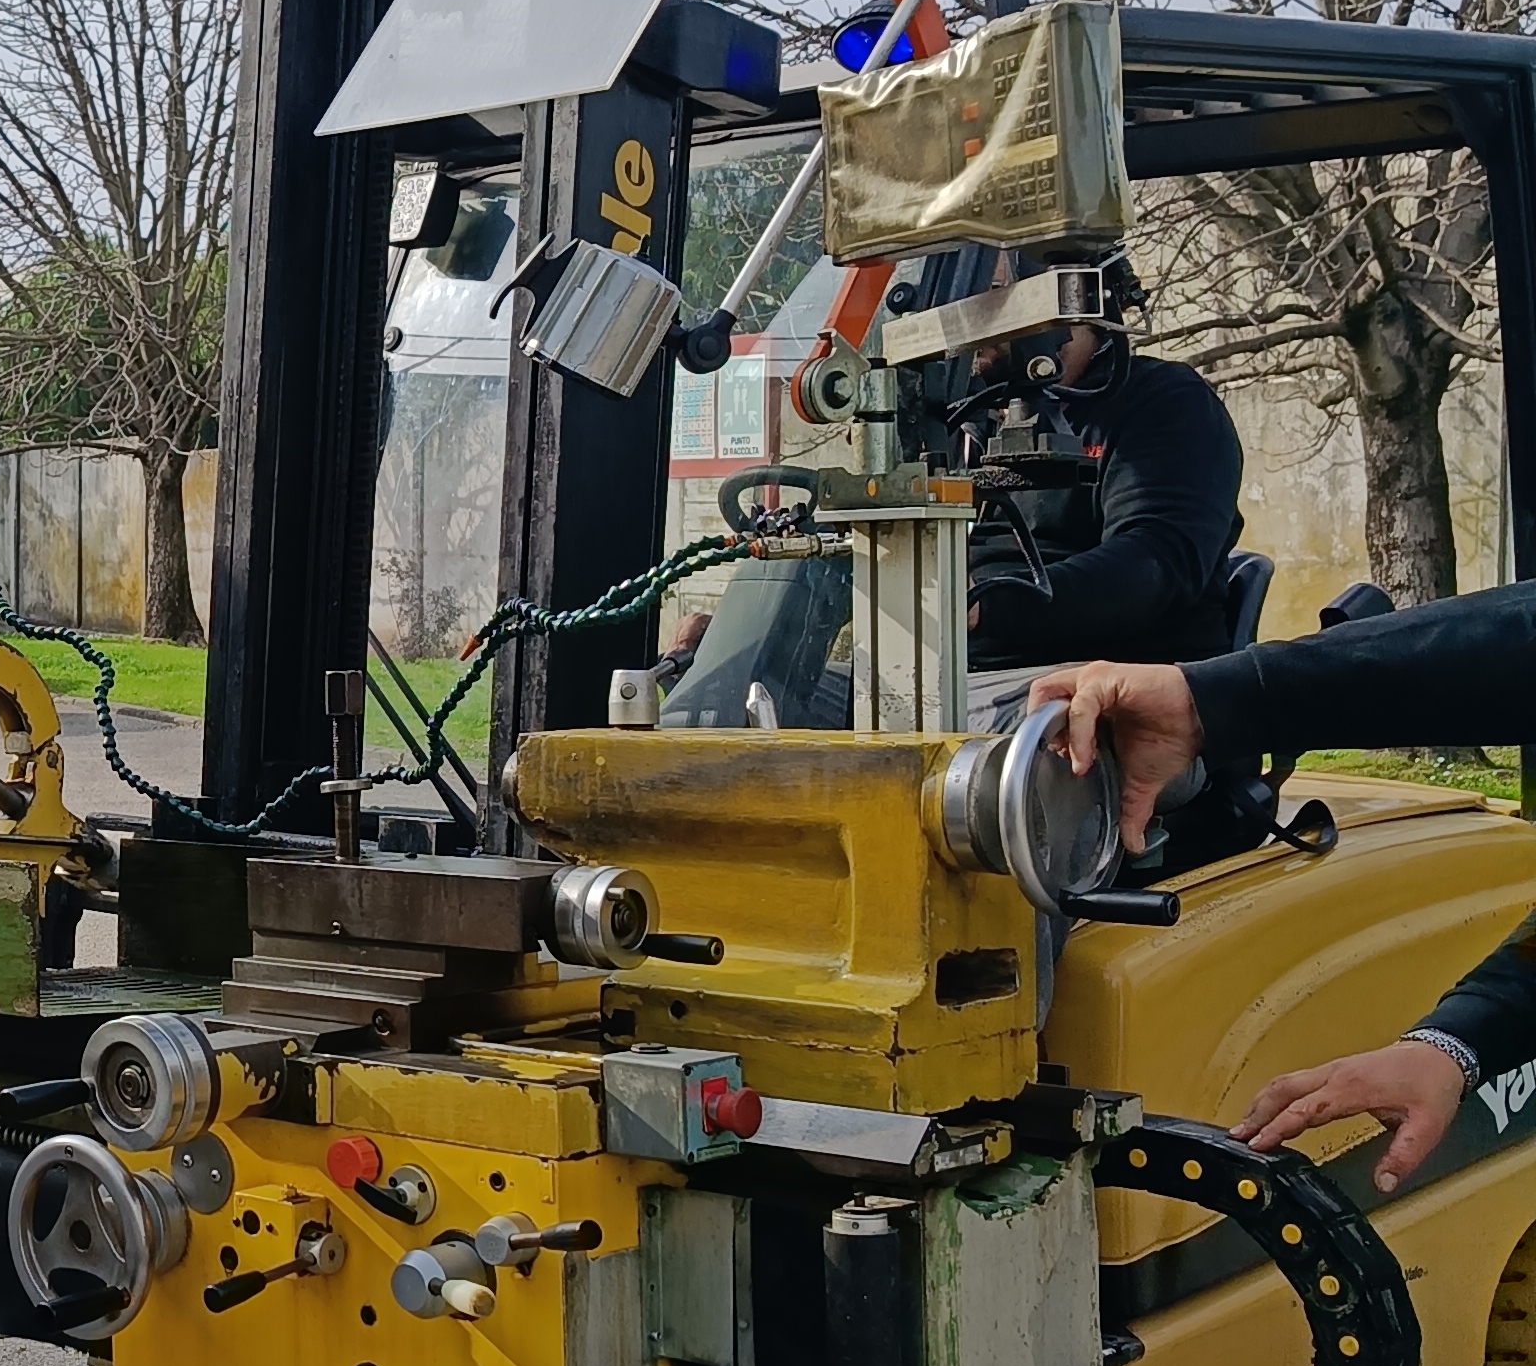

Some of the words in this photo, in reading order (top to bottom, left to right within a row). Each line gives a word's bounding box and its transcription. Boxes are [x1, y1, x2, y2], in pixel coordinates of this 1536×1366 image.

[730, 436, 751, 445] PUNTO
[723, 447, 729, 455] DI
[729, 446, 759, 455] RACCOLTA
[1476, 1058, 1536, 1135] Ya
[1404, 1265, 1424, 1281] Yale
